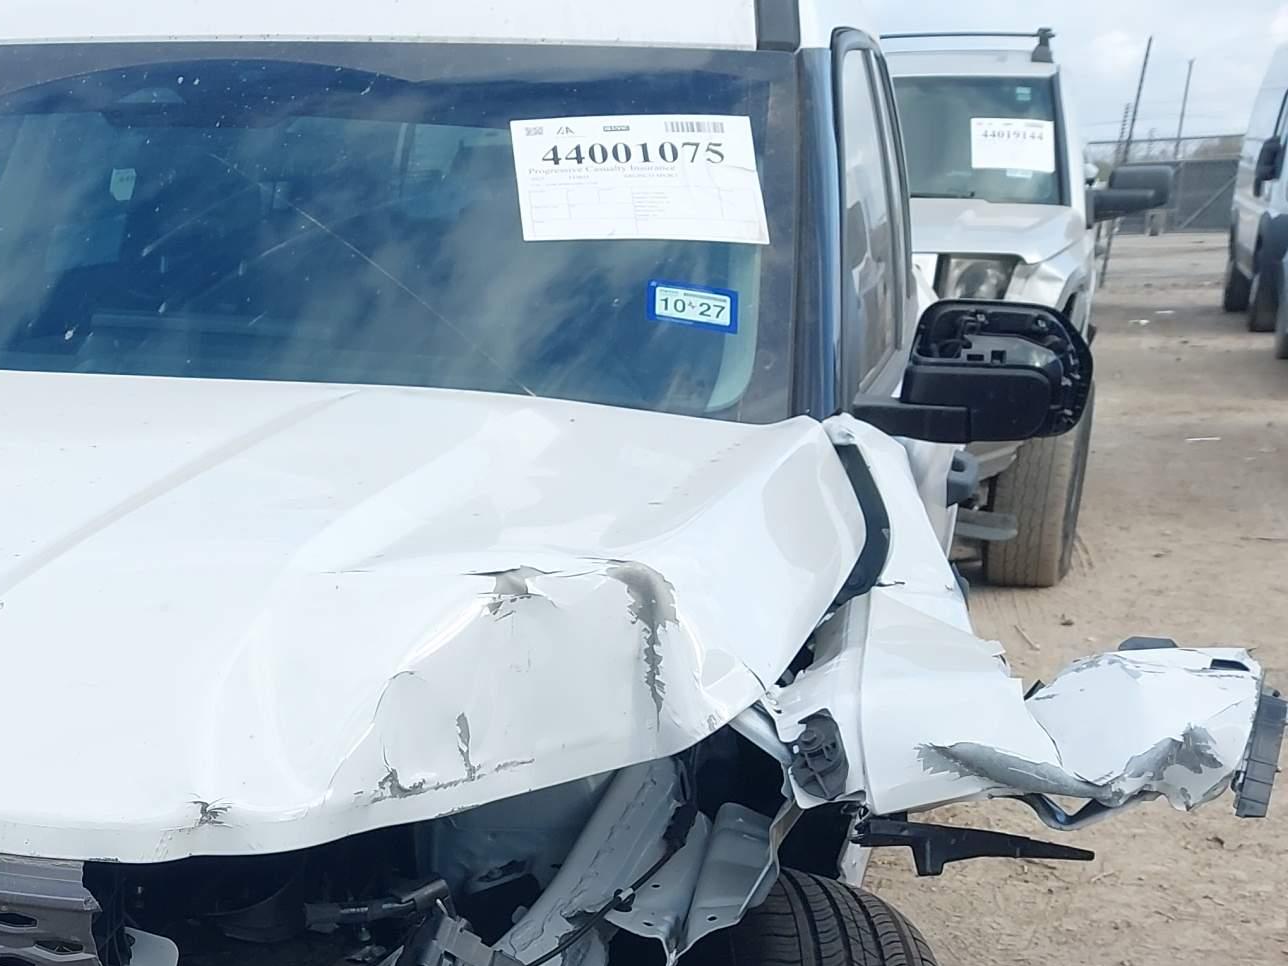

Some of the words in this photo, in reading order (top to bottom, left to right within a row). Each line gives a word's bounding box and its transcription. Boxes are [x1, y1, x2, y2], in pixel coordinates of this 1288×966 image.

[542, 142, 725, 165] 44001075
[660, 297, 686, 313] 10
[698, 302, 726, 319] 27
